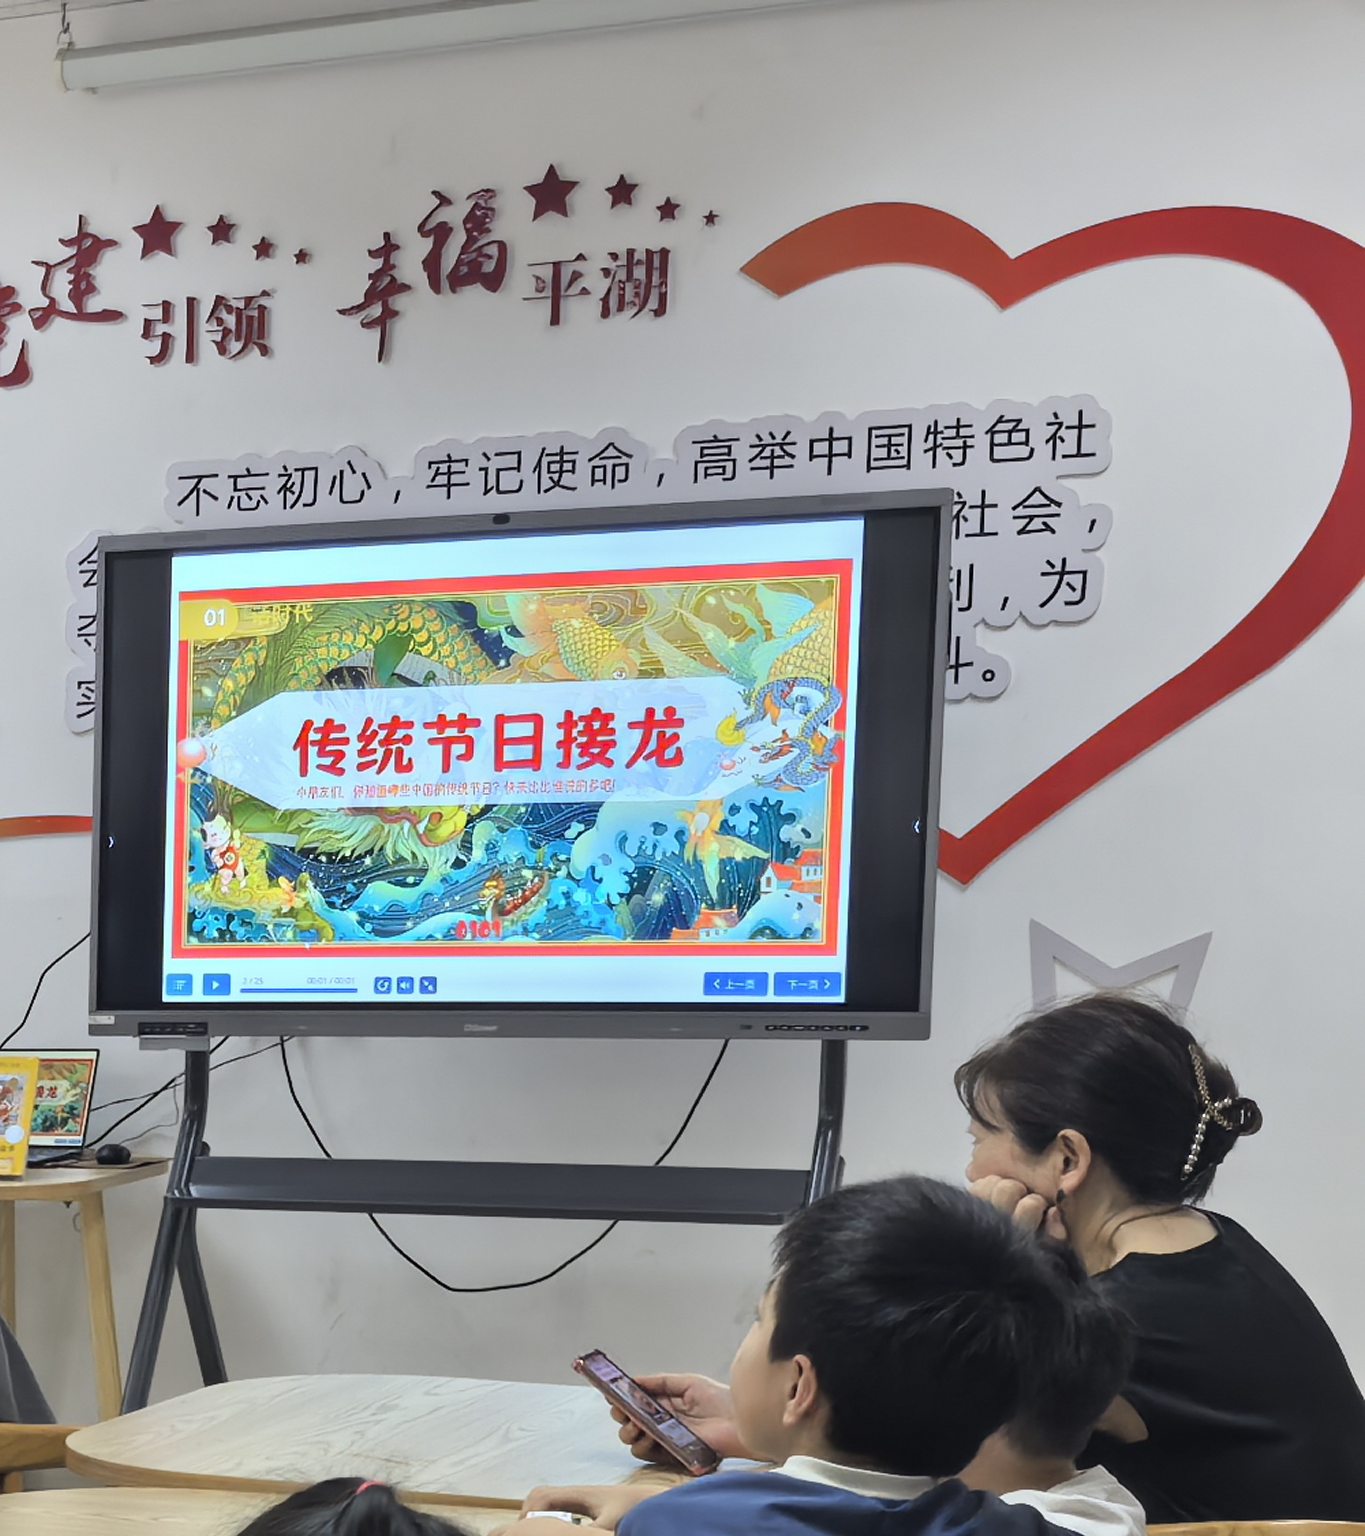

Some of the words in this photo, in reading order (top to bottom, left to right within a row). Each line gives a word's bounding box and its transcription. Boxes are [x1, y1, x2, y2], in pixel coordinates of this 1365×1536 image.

[203, 608, 226, 628] 01
[292, 705, 685, 779] 传统节日接龙
[724, 978, 756, 991] 上一页
[787, 978, 819, 991] 下一页
